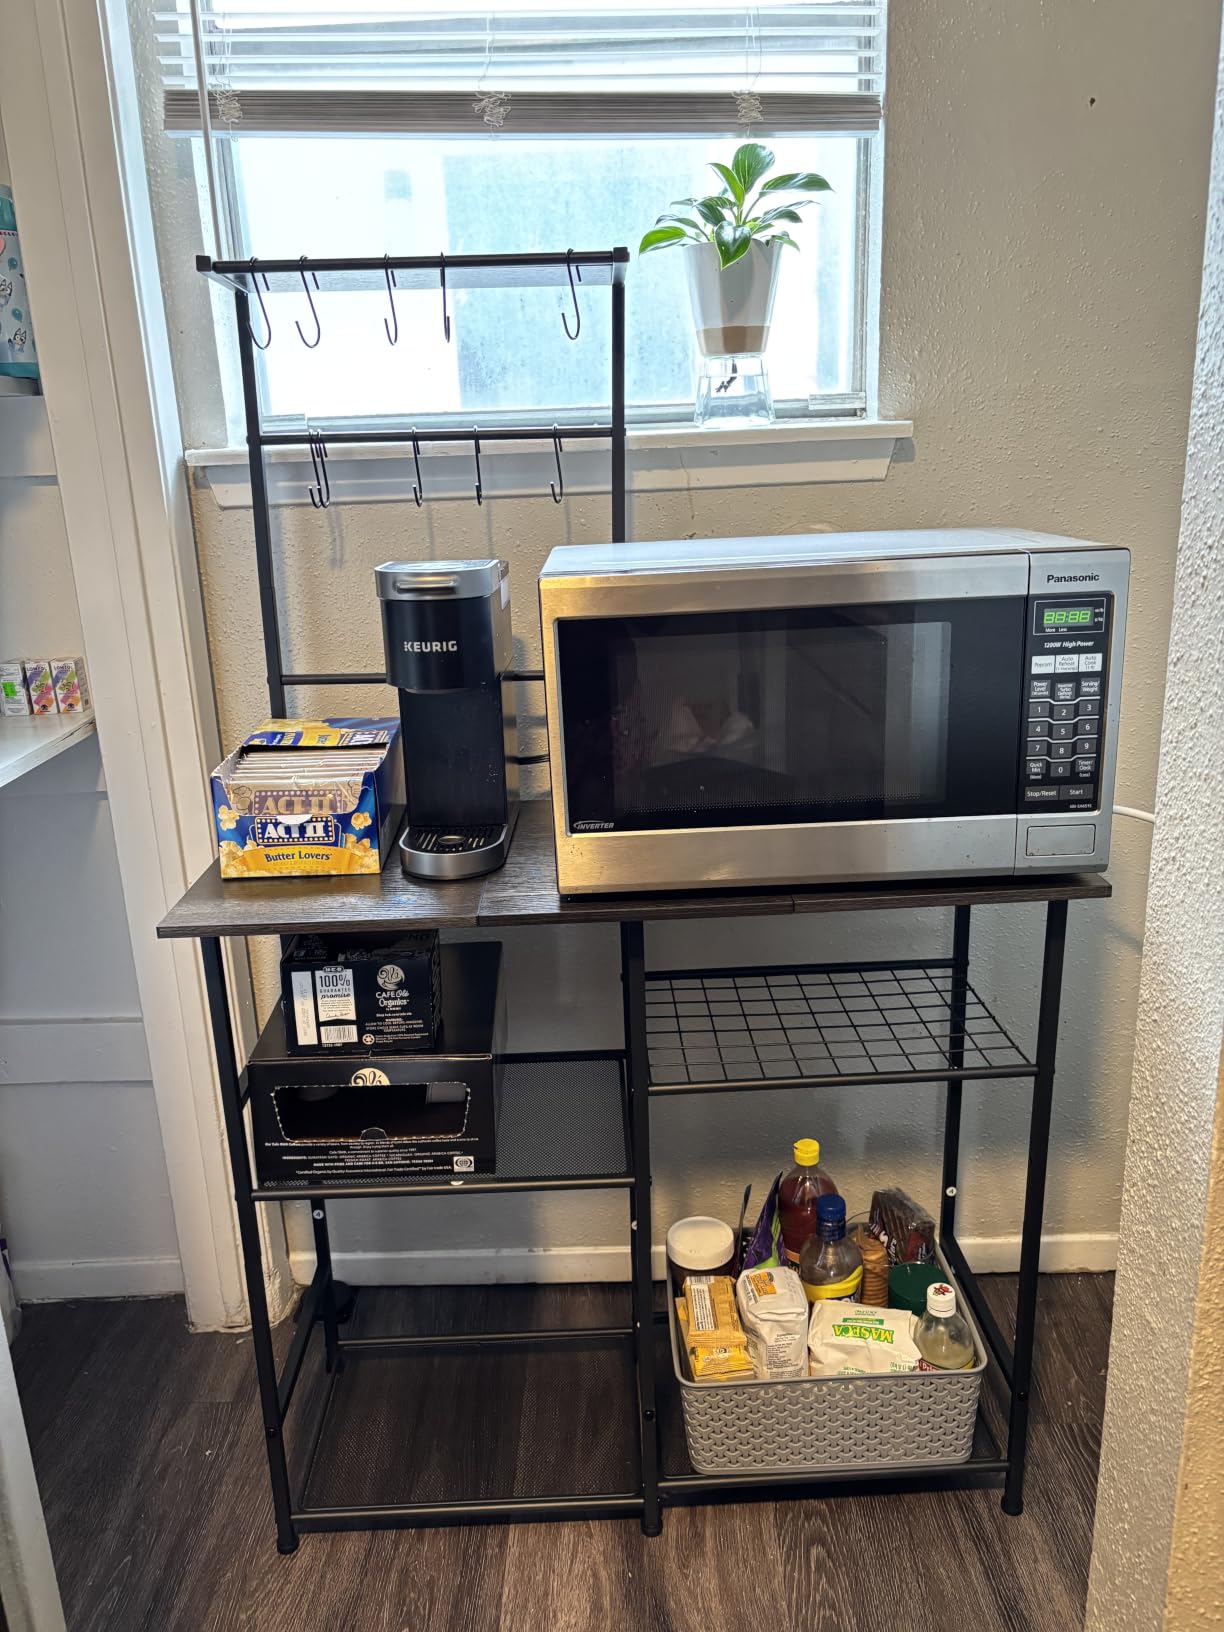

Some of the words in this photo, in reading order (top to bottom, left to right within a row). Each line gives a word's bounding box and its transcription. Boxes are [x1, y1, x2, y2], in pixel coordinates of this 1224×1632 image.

[1047, 573, 1100, 584] Panasonic
[404, 641, 458, 652] KEURIG
[1062, 641, 1077, 649] High
[1027, 790, 1057, 798] Stop/Reset
[264, 823, 300, 838] ACT
[304, 821, 326, 837] II
[576, 821, 615, 830] INVERTER
[264, 851, 295, 863] Butter
[299, 850, 331, 861] Lovers
[319, 973, 351, 988] 100%
[375, 991, 396, 999] CAFE
[832, 1324, 894, 1345] MASECA
